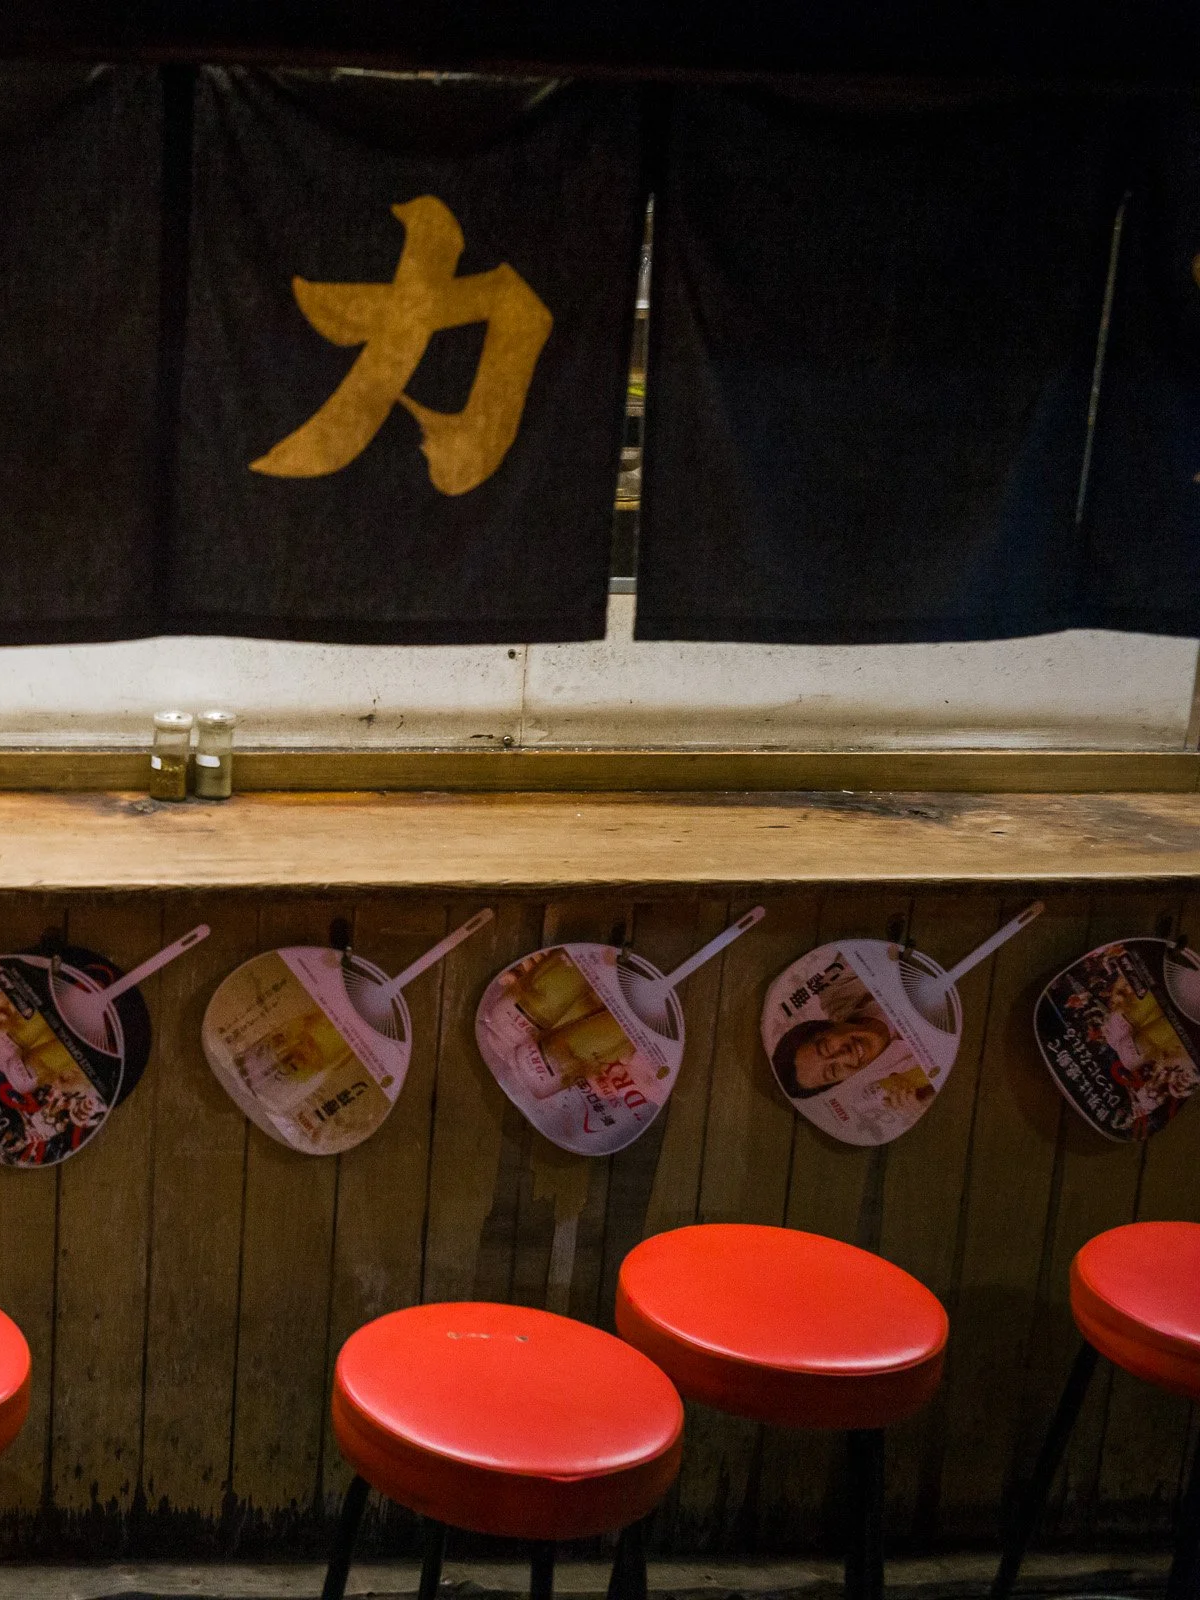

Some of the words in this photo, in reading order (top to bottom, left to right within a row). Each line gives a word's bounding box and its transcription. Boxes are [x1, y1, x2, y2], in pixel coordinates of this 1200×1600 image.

[249, 194, 554, 497] 力
[781, 962, 845, 1017] 一番搾り
